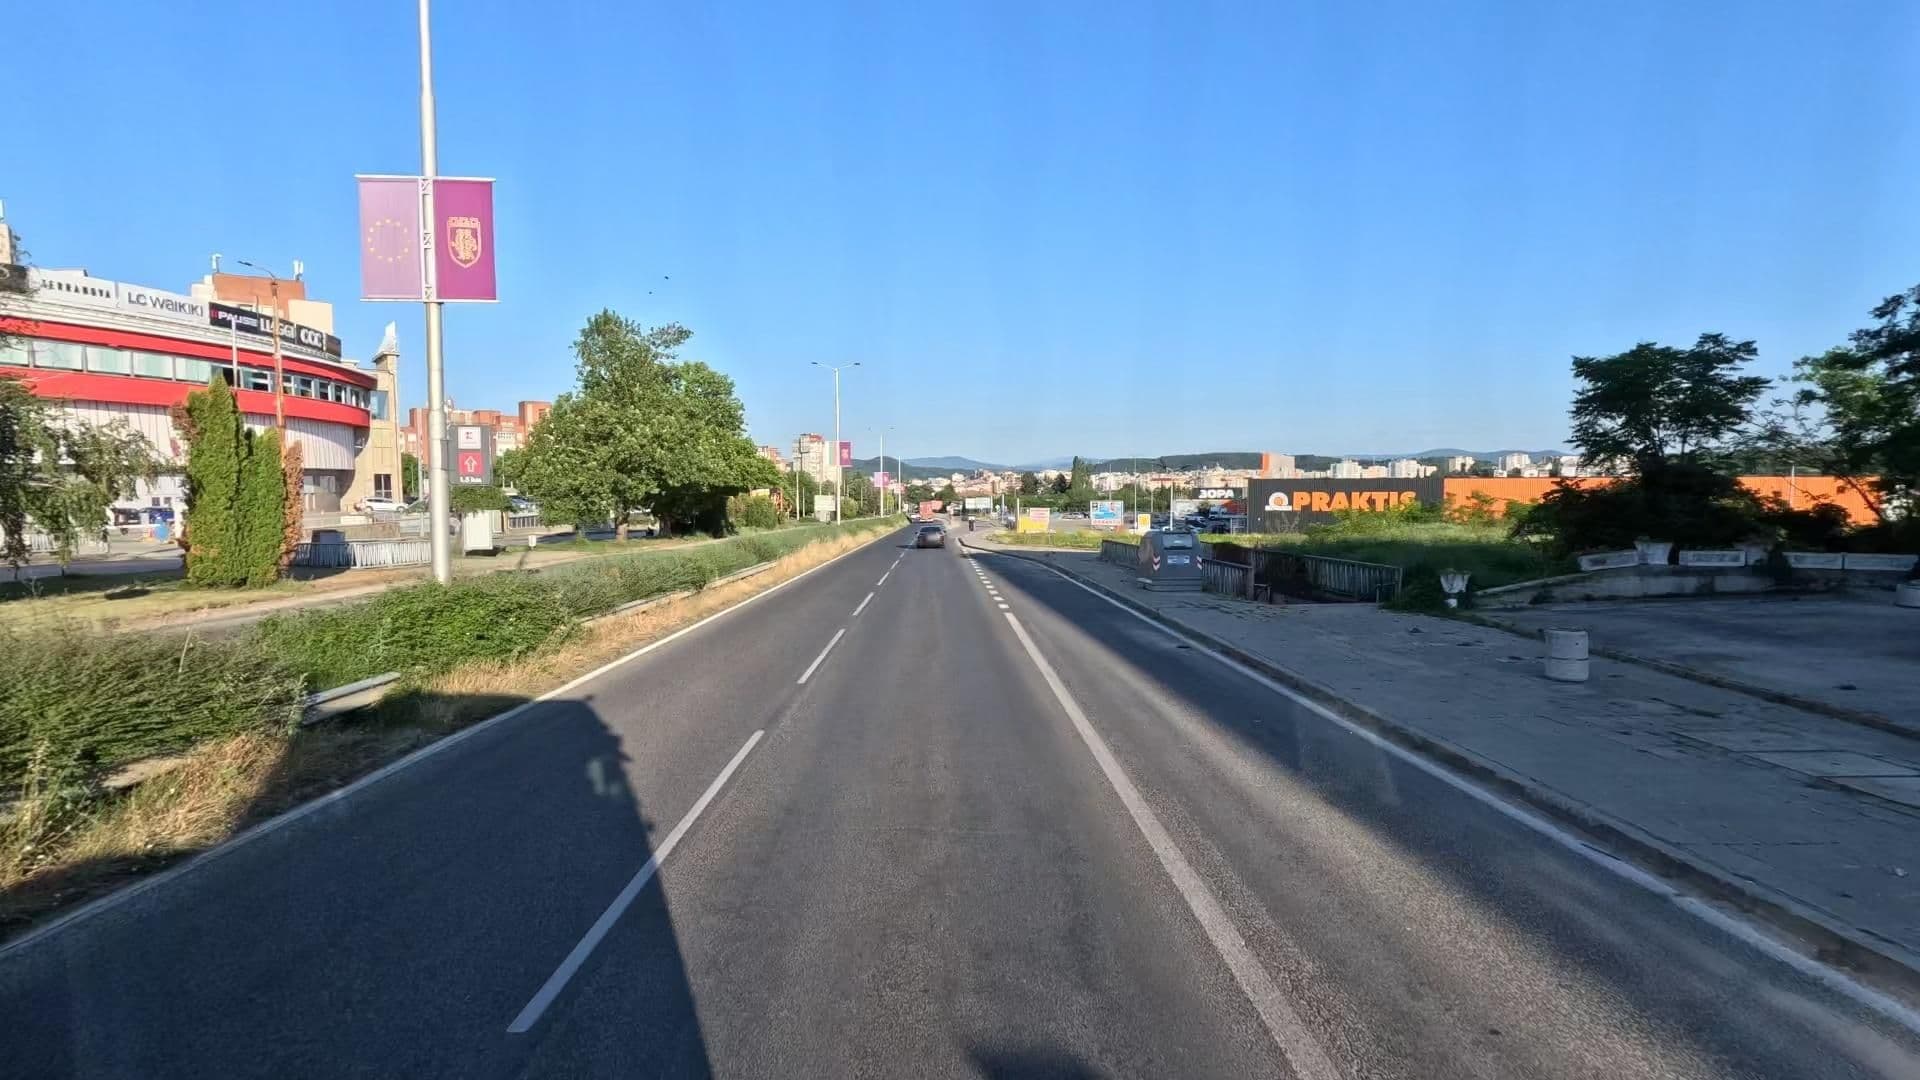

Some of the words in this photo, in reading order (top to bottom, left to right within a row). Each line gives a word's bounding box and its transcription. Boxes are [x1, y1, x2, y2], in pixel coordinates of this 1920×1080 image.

[128, 291, 147, 307] LC
[300, 328, 323, 348] CCC
[1199, 489, 1235, 499] ЗОРА
[1292, 490, 1416, 513] PRAKTIS
